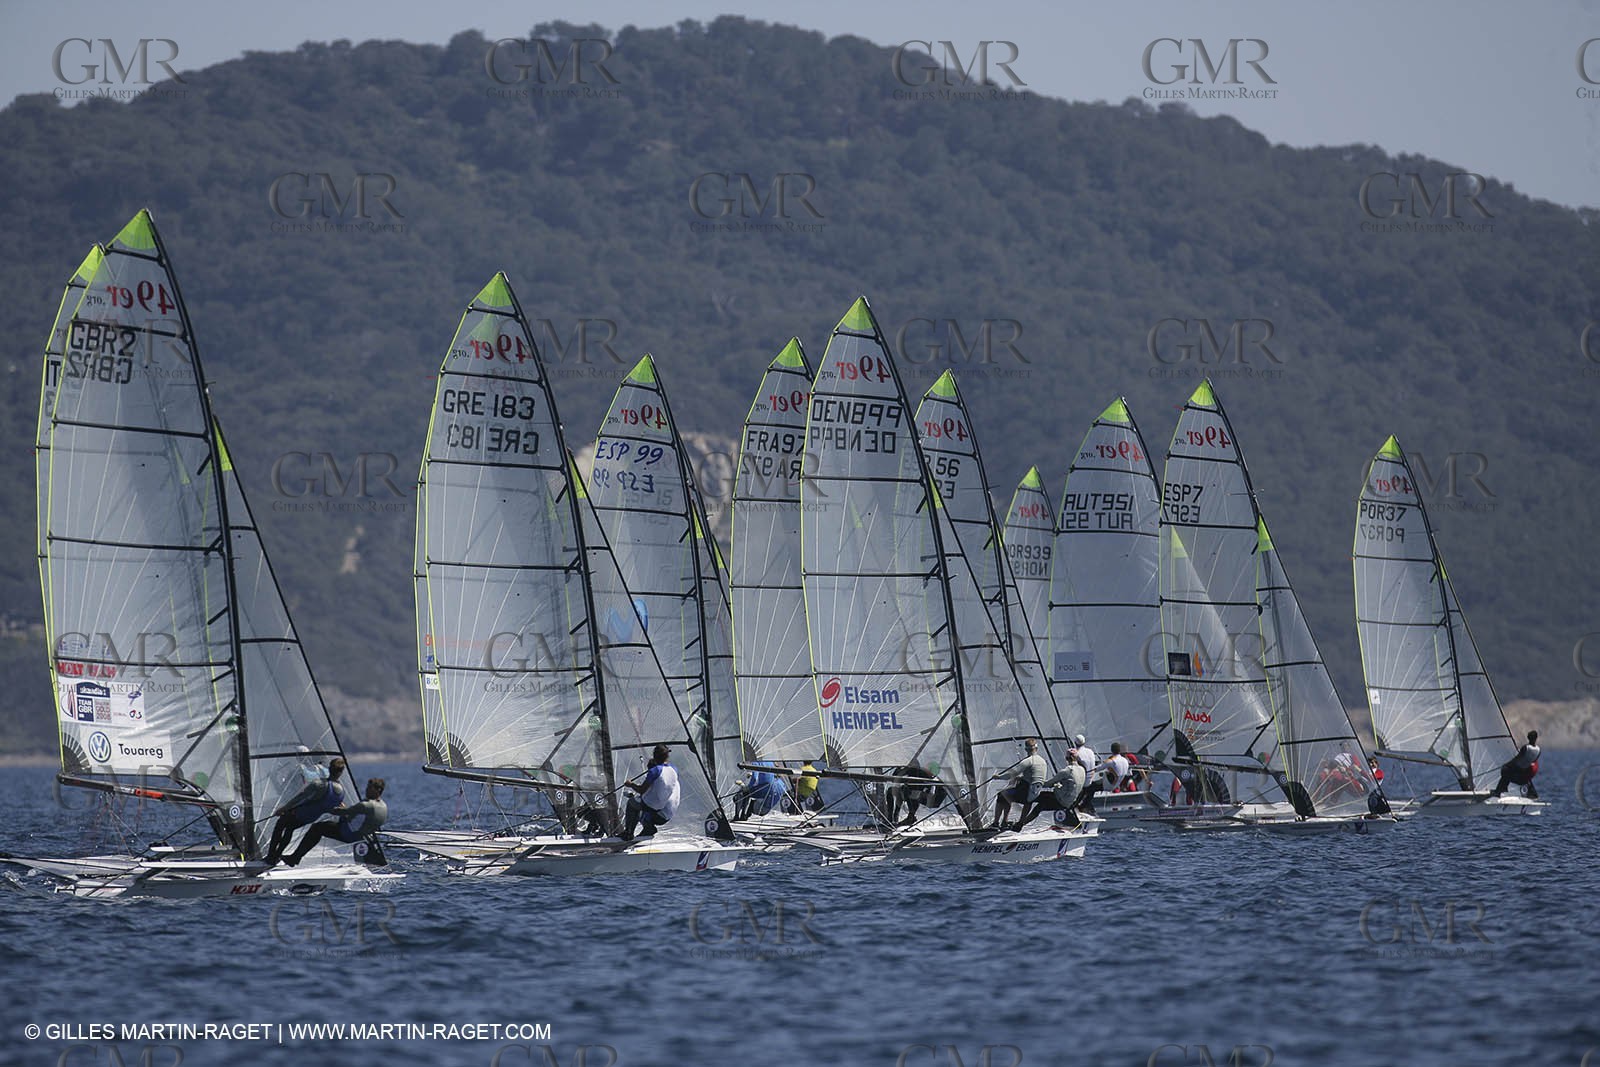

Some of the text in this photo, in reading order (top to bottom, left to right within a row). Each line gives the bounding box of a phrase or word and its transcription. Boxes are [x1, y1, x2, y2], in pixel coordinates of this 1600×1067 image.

[70, 323, 137, 358] GBR2
[443, 389, 536, 421] GRE 183
[812, 399, 903, 428] DEN899
[596, 440, 664, 466] ESP 99
[935, 456, 961, 478] 56
[1063, 492, 1134, 512] AUT951
[1163, 482, 1204, 504] ESP7
[1360, 503, 1408, 522] POR37
[844, 686, 900, 704] Elsam
[832, 712, 903, 730] HEMPEL
[1184, 710, 1212, 723] Audi
[118, 743, 164, 759] Touareg
